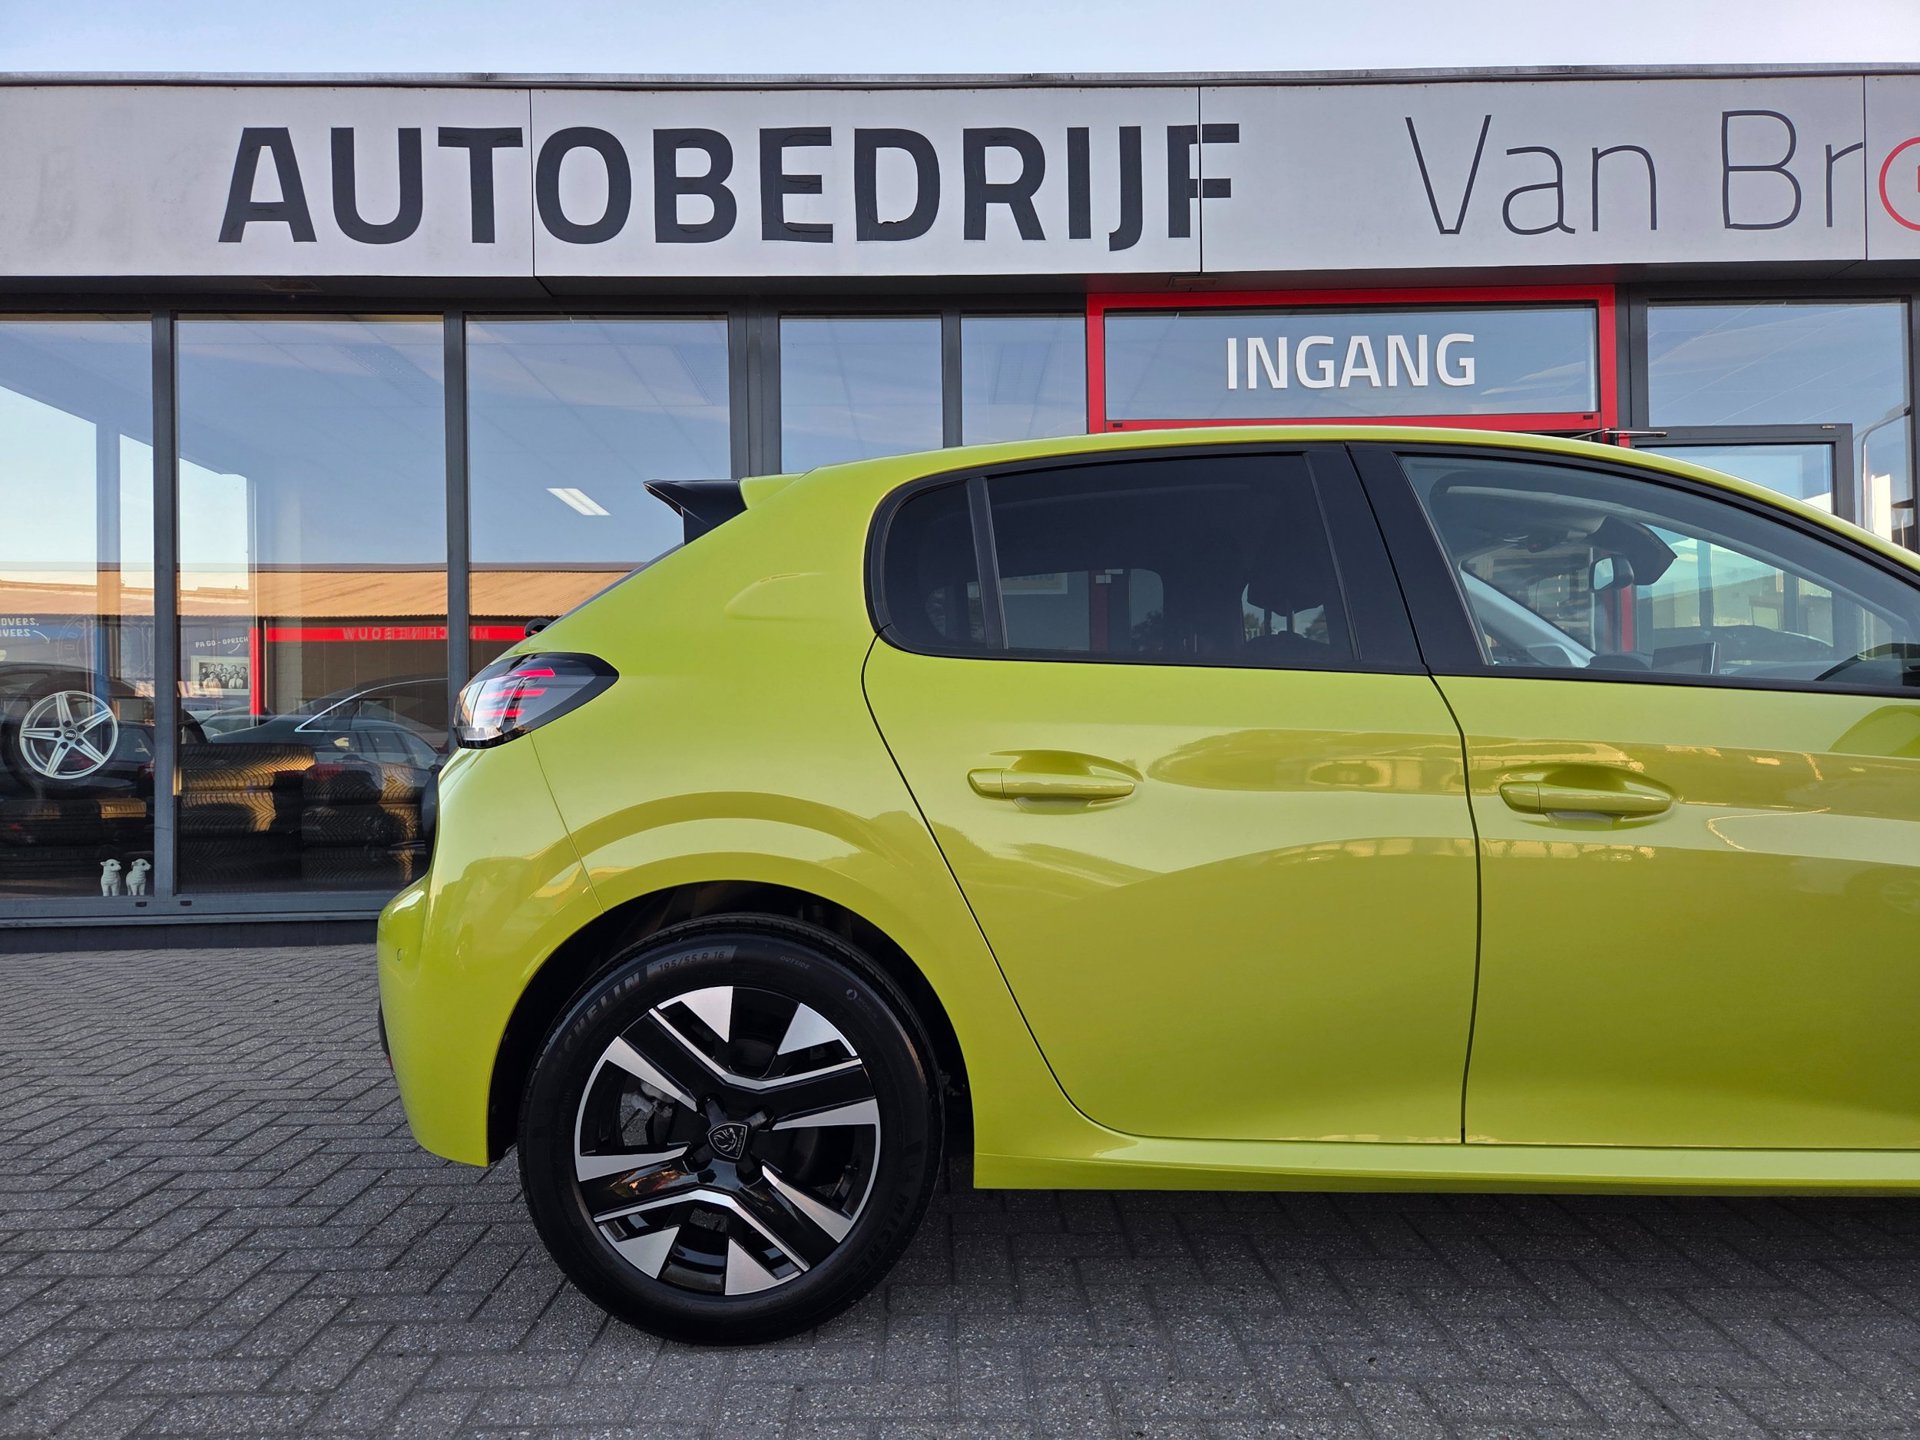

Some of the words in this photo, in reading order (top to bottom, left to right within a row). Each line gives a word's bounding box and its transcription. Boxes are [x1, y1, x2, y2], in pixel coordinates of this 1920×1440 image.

[218, 123, 1240, 251] AUTOBEDRIJF
[1405, 114, 1658, 236] Van
[1227, 333, 1476, 390] INGANG
[659, 954, 698, 972] 195/55
[713, 950, 726, 960] 16
